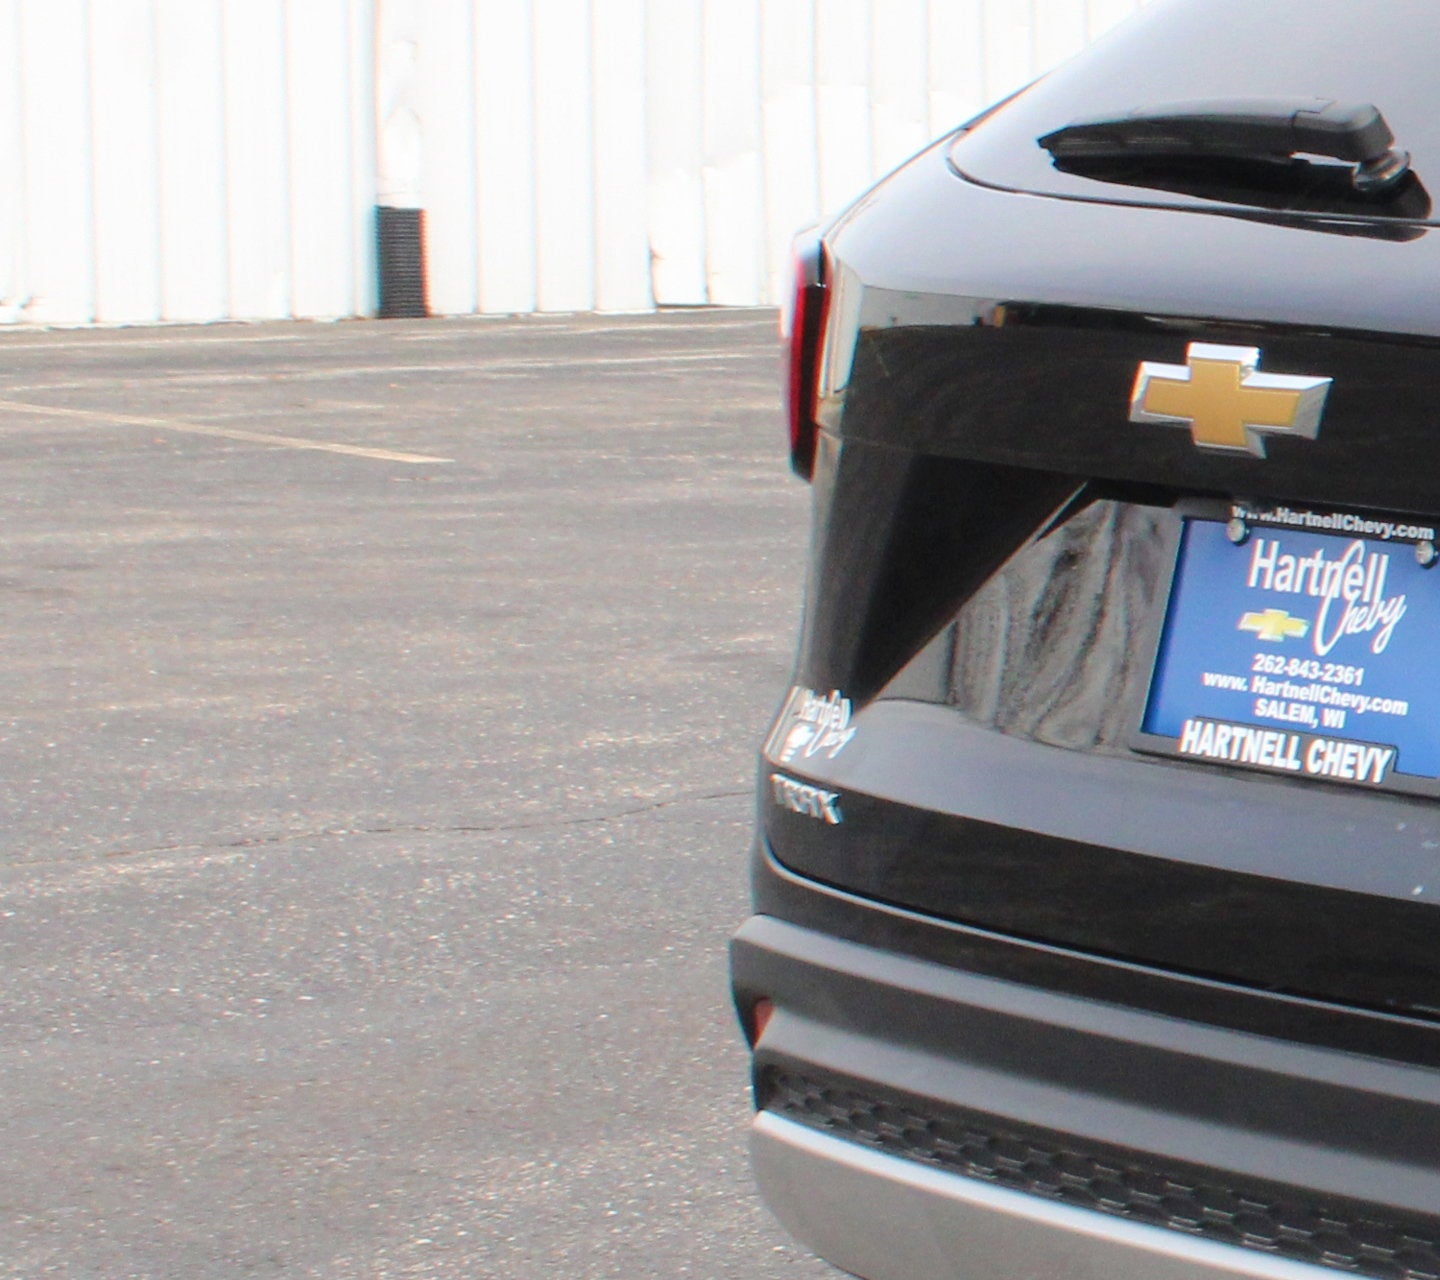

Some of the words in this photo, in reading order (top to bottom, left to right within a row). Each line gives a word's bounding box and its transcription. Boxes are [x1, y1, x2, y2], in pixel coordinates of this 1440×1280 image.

[1247, 538, 1390, 602] Hartnell
[1314, 539, 1408, 657] Chevy
[1202, 672, 1249, 693] www.
[1251, 676, 1409, 717] HartnellChevy.com
[1252, 653, 1365, 686] 262-843-2361
[1254, 698, 1319, 729] SALEM,
[1321, 707, 1347, 729] WI
[1179, 719, 1302, 771] HARTNELL
[1305, 738, 1394, 784] CHEVY
